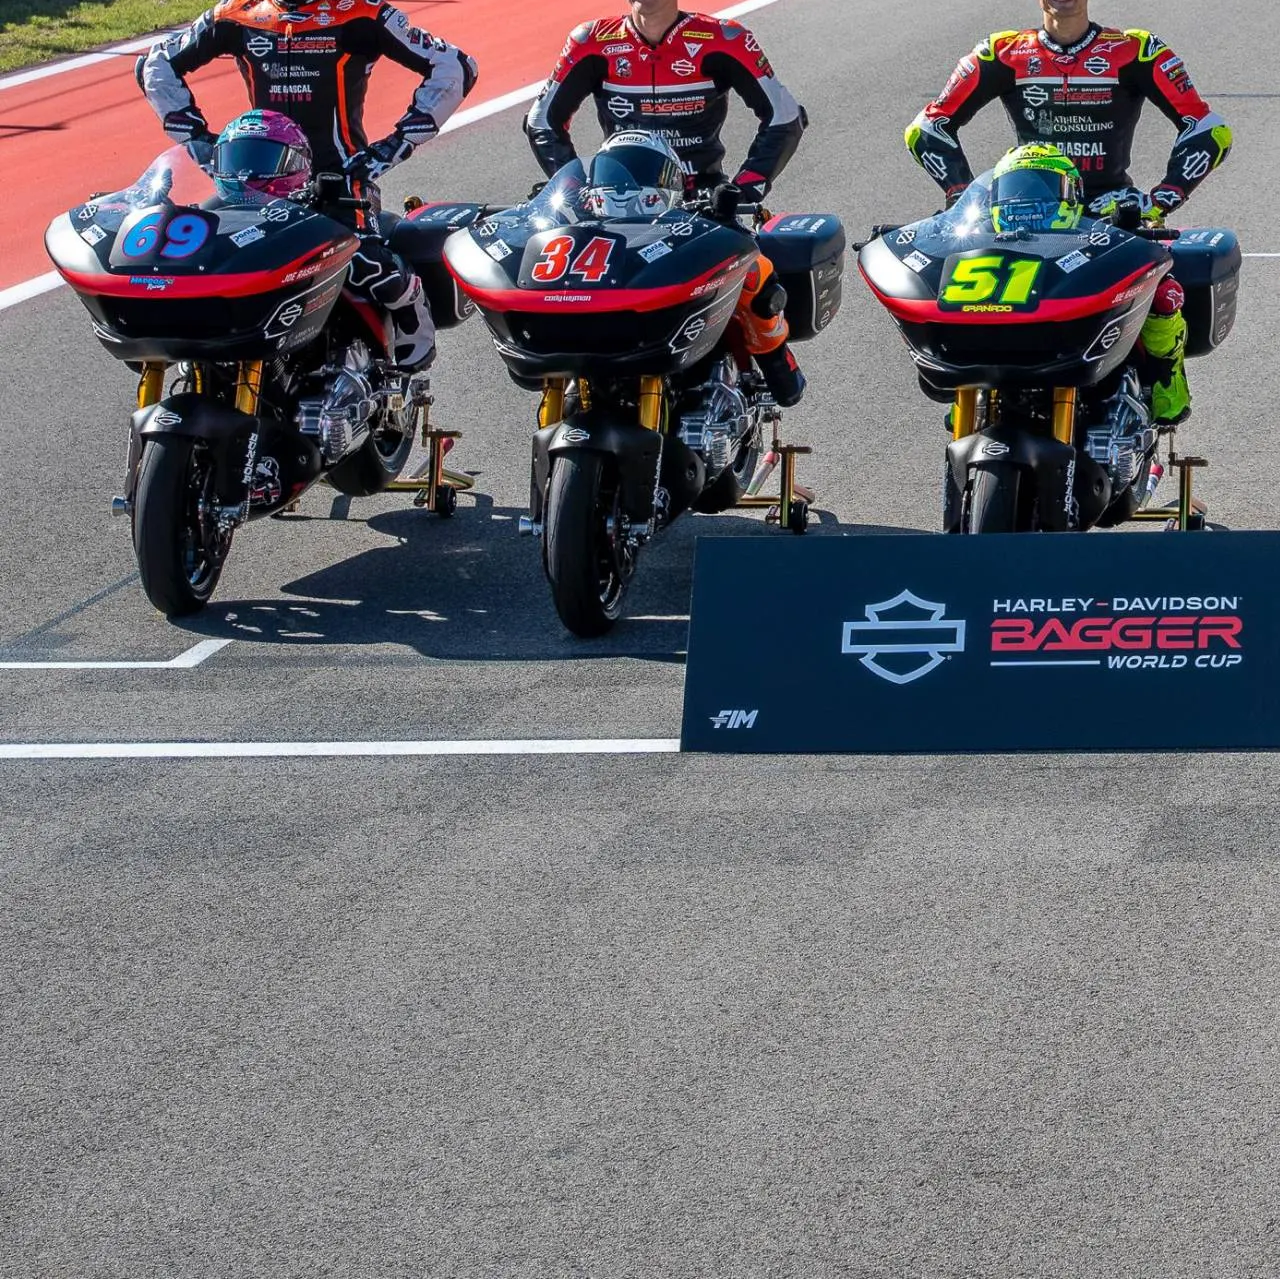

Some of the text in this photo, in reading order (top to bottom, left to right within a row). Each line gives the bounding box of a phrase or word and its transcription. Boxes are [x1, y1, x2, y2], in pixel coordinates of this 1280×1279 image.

[606, 44, 630, 54] SHOEI
[270, 84, 312, 93] JOE RASCAL
[641, 101, 706, 112] BAGGER
[1053, 115, 1092, 123] ATHENA
[1053, 121, 1113, 132] CONSULTING
[1057, 142, 1107, 156] RASCAL
[1051, 201, 1084, 229] 51
[122, 212, 210, 259] 69
[531, 235, 617, 283] 34
[130, 277, 165, 285] MADDOG
[942, 255, 1042, 304] 51
[146, 283, 166, 291] Racing
[962, 304, 1012, 312] GRANADO
[991, 616, 1243, 651] BAGGER
[1106, 654, 1242, 669] WORLD CUP
[710, 709, 759, 729] FIM
